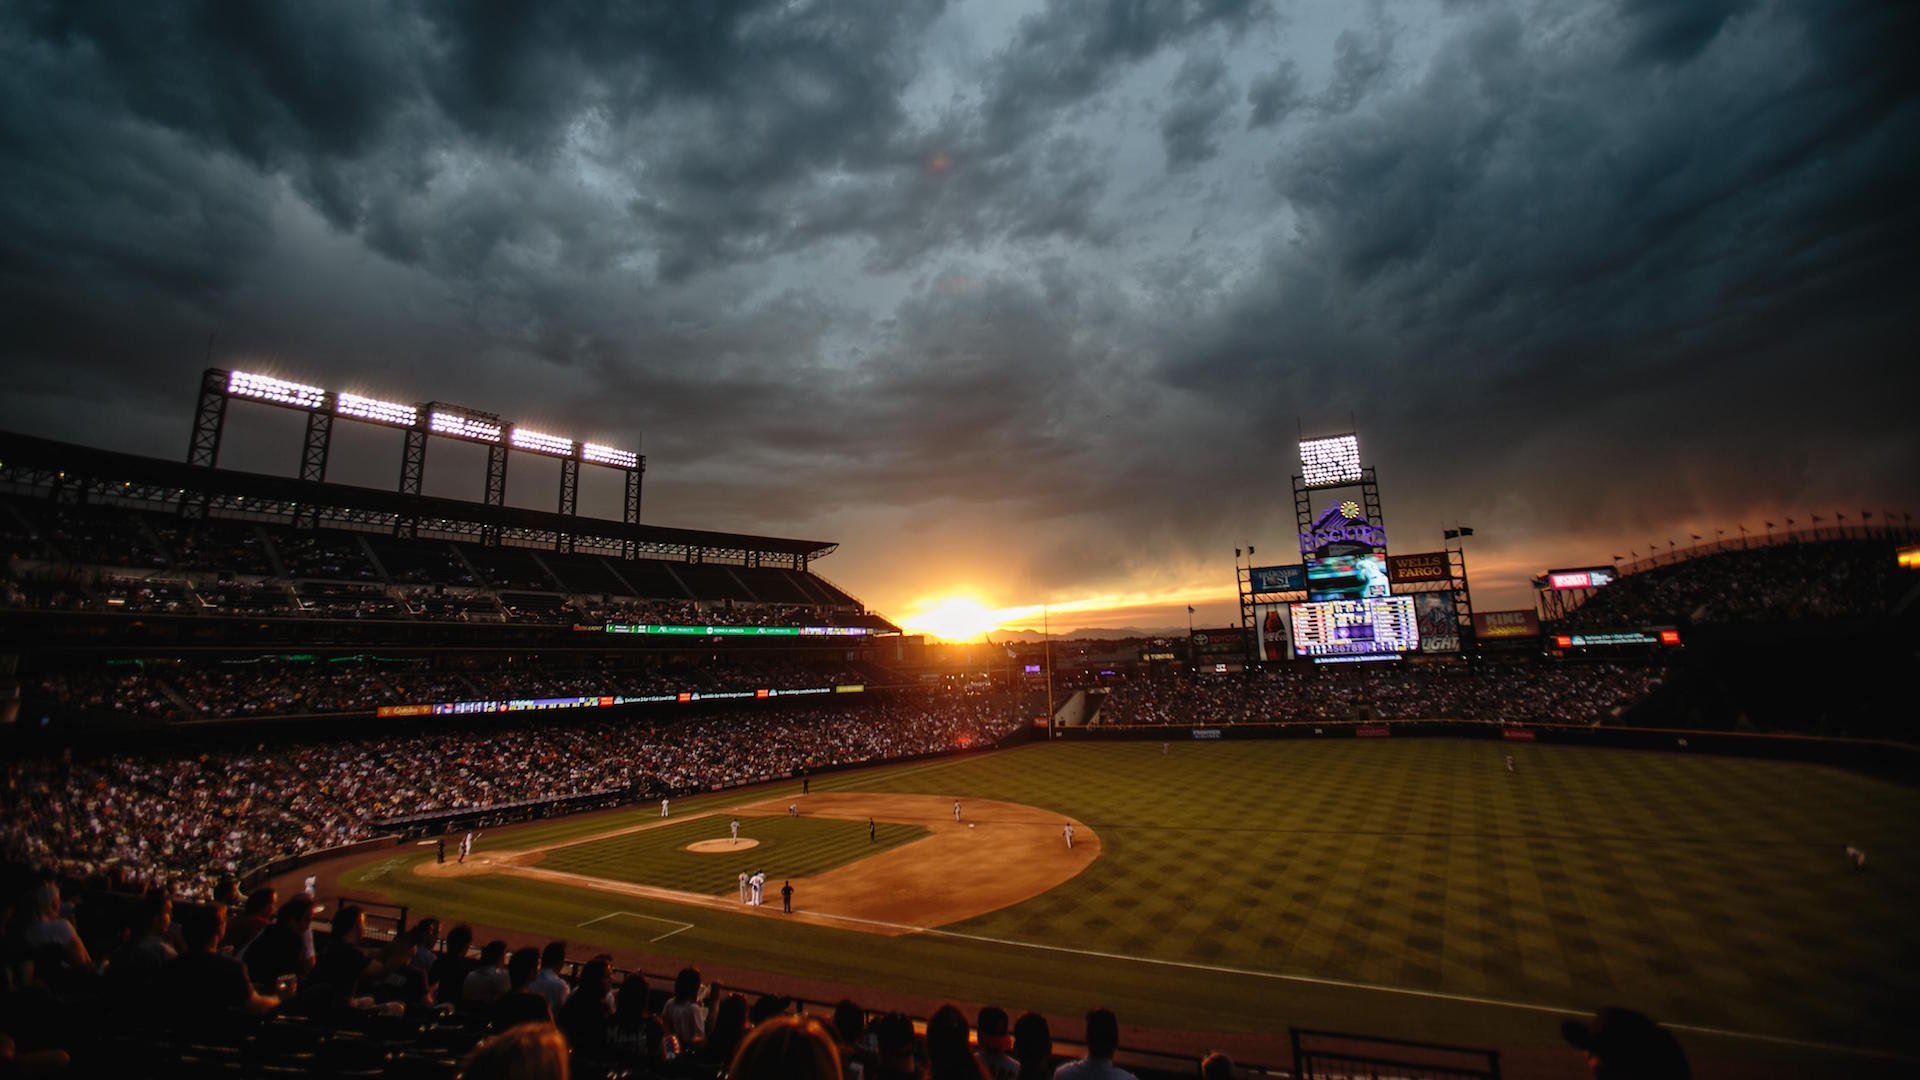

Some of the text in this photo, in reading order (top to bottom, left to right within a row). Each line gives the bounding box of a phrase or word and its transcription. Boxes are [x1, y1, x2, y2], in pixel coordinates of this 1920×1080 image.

[1396, 557, 1441, 568] WELLS
[1398, 566, 1442, 577] FARGO
[1208, 635, 1243, 643] TOYOTA
